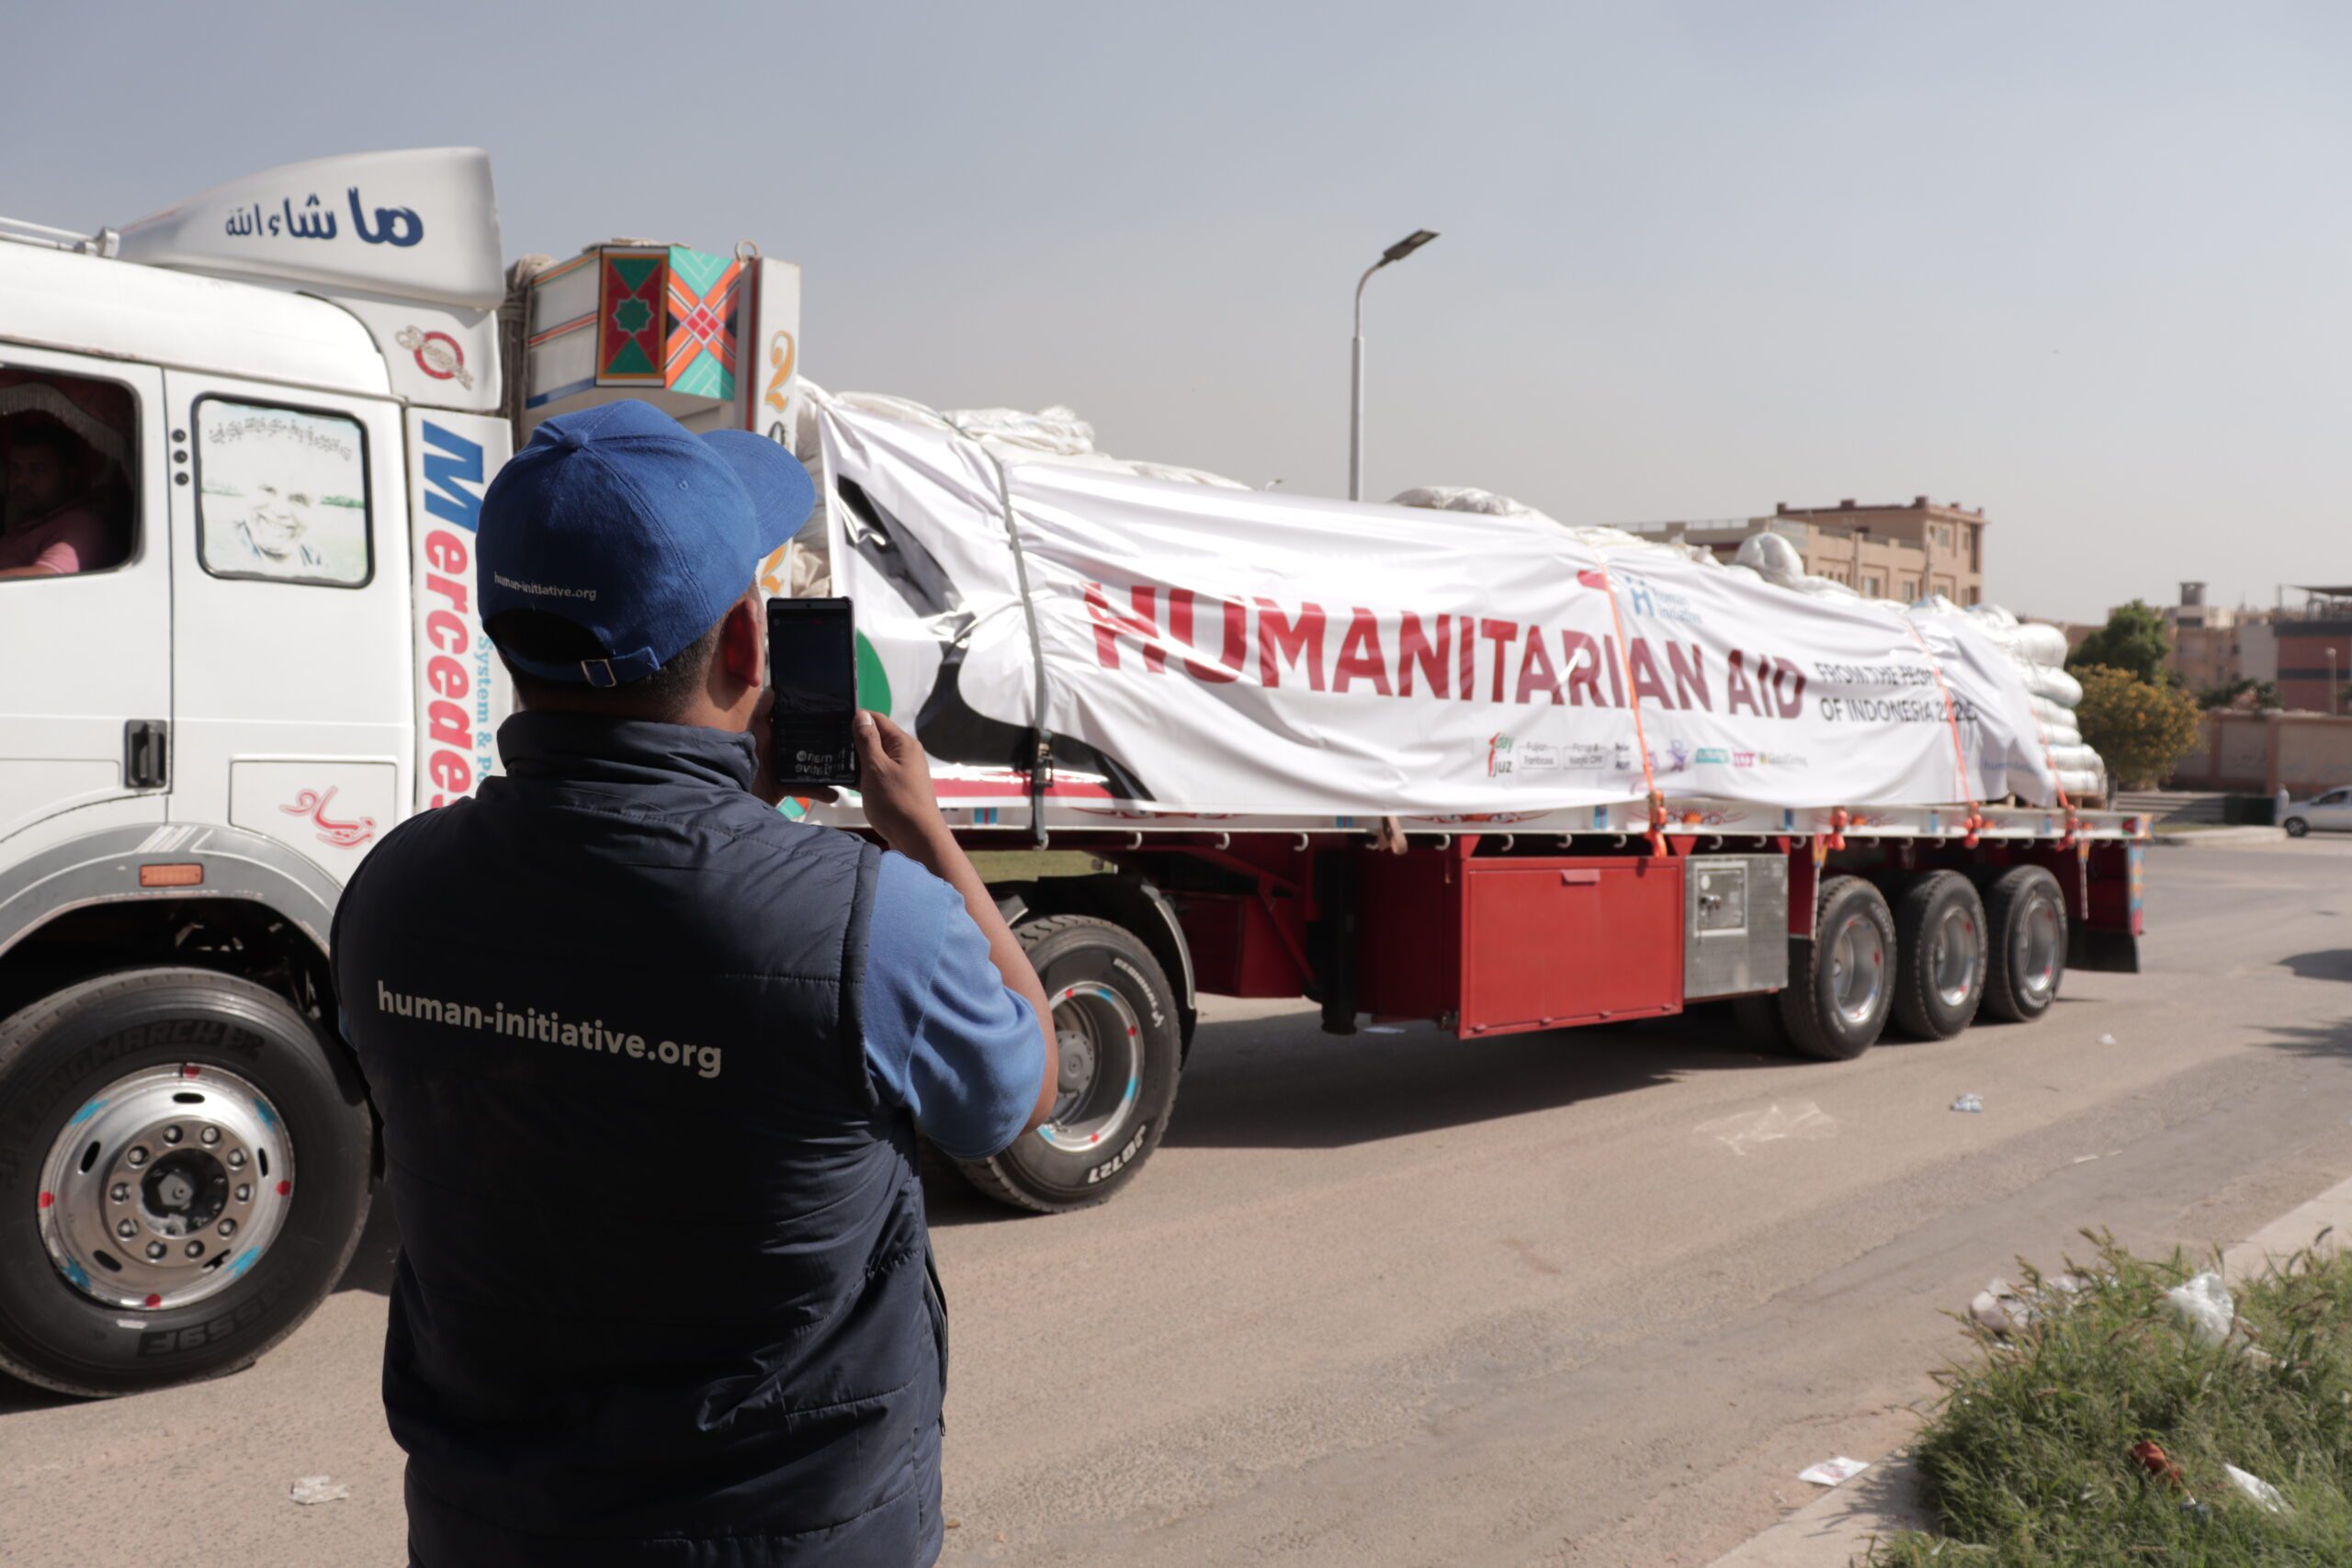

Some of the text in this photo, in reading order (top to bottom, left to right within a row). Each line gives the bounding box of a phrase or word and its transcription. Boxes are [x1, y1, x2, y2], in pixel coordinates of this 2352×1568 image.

[268, 193, 337, 240] شاء
[347, 186, 424, 247] ما
[494, 570, 596, 601] human-initiative.org
[422, 419, 483, 808] Mercede
[1080, 582, 1807, 719] HUMANITARIAN AID
[1814, 661, 1864, 684] FROM
[474, 636, 493, 724] System
[1819, 696, 1843, 722] OF
[1845, 697, 1936, 723] INDONESIA
[477, 731, 492, 748] &
[378, 979, 722, 1078] human-initiative.org
